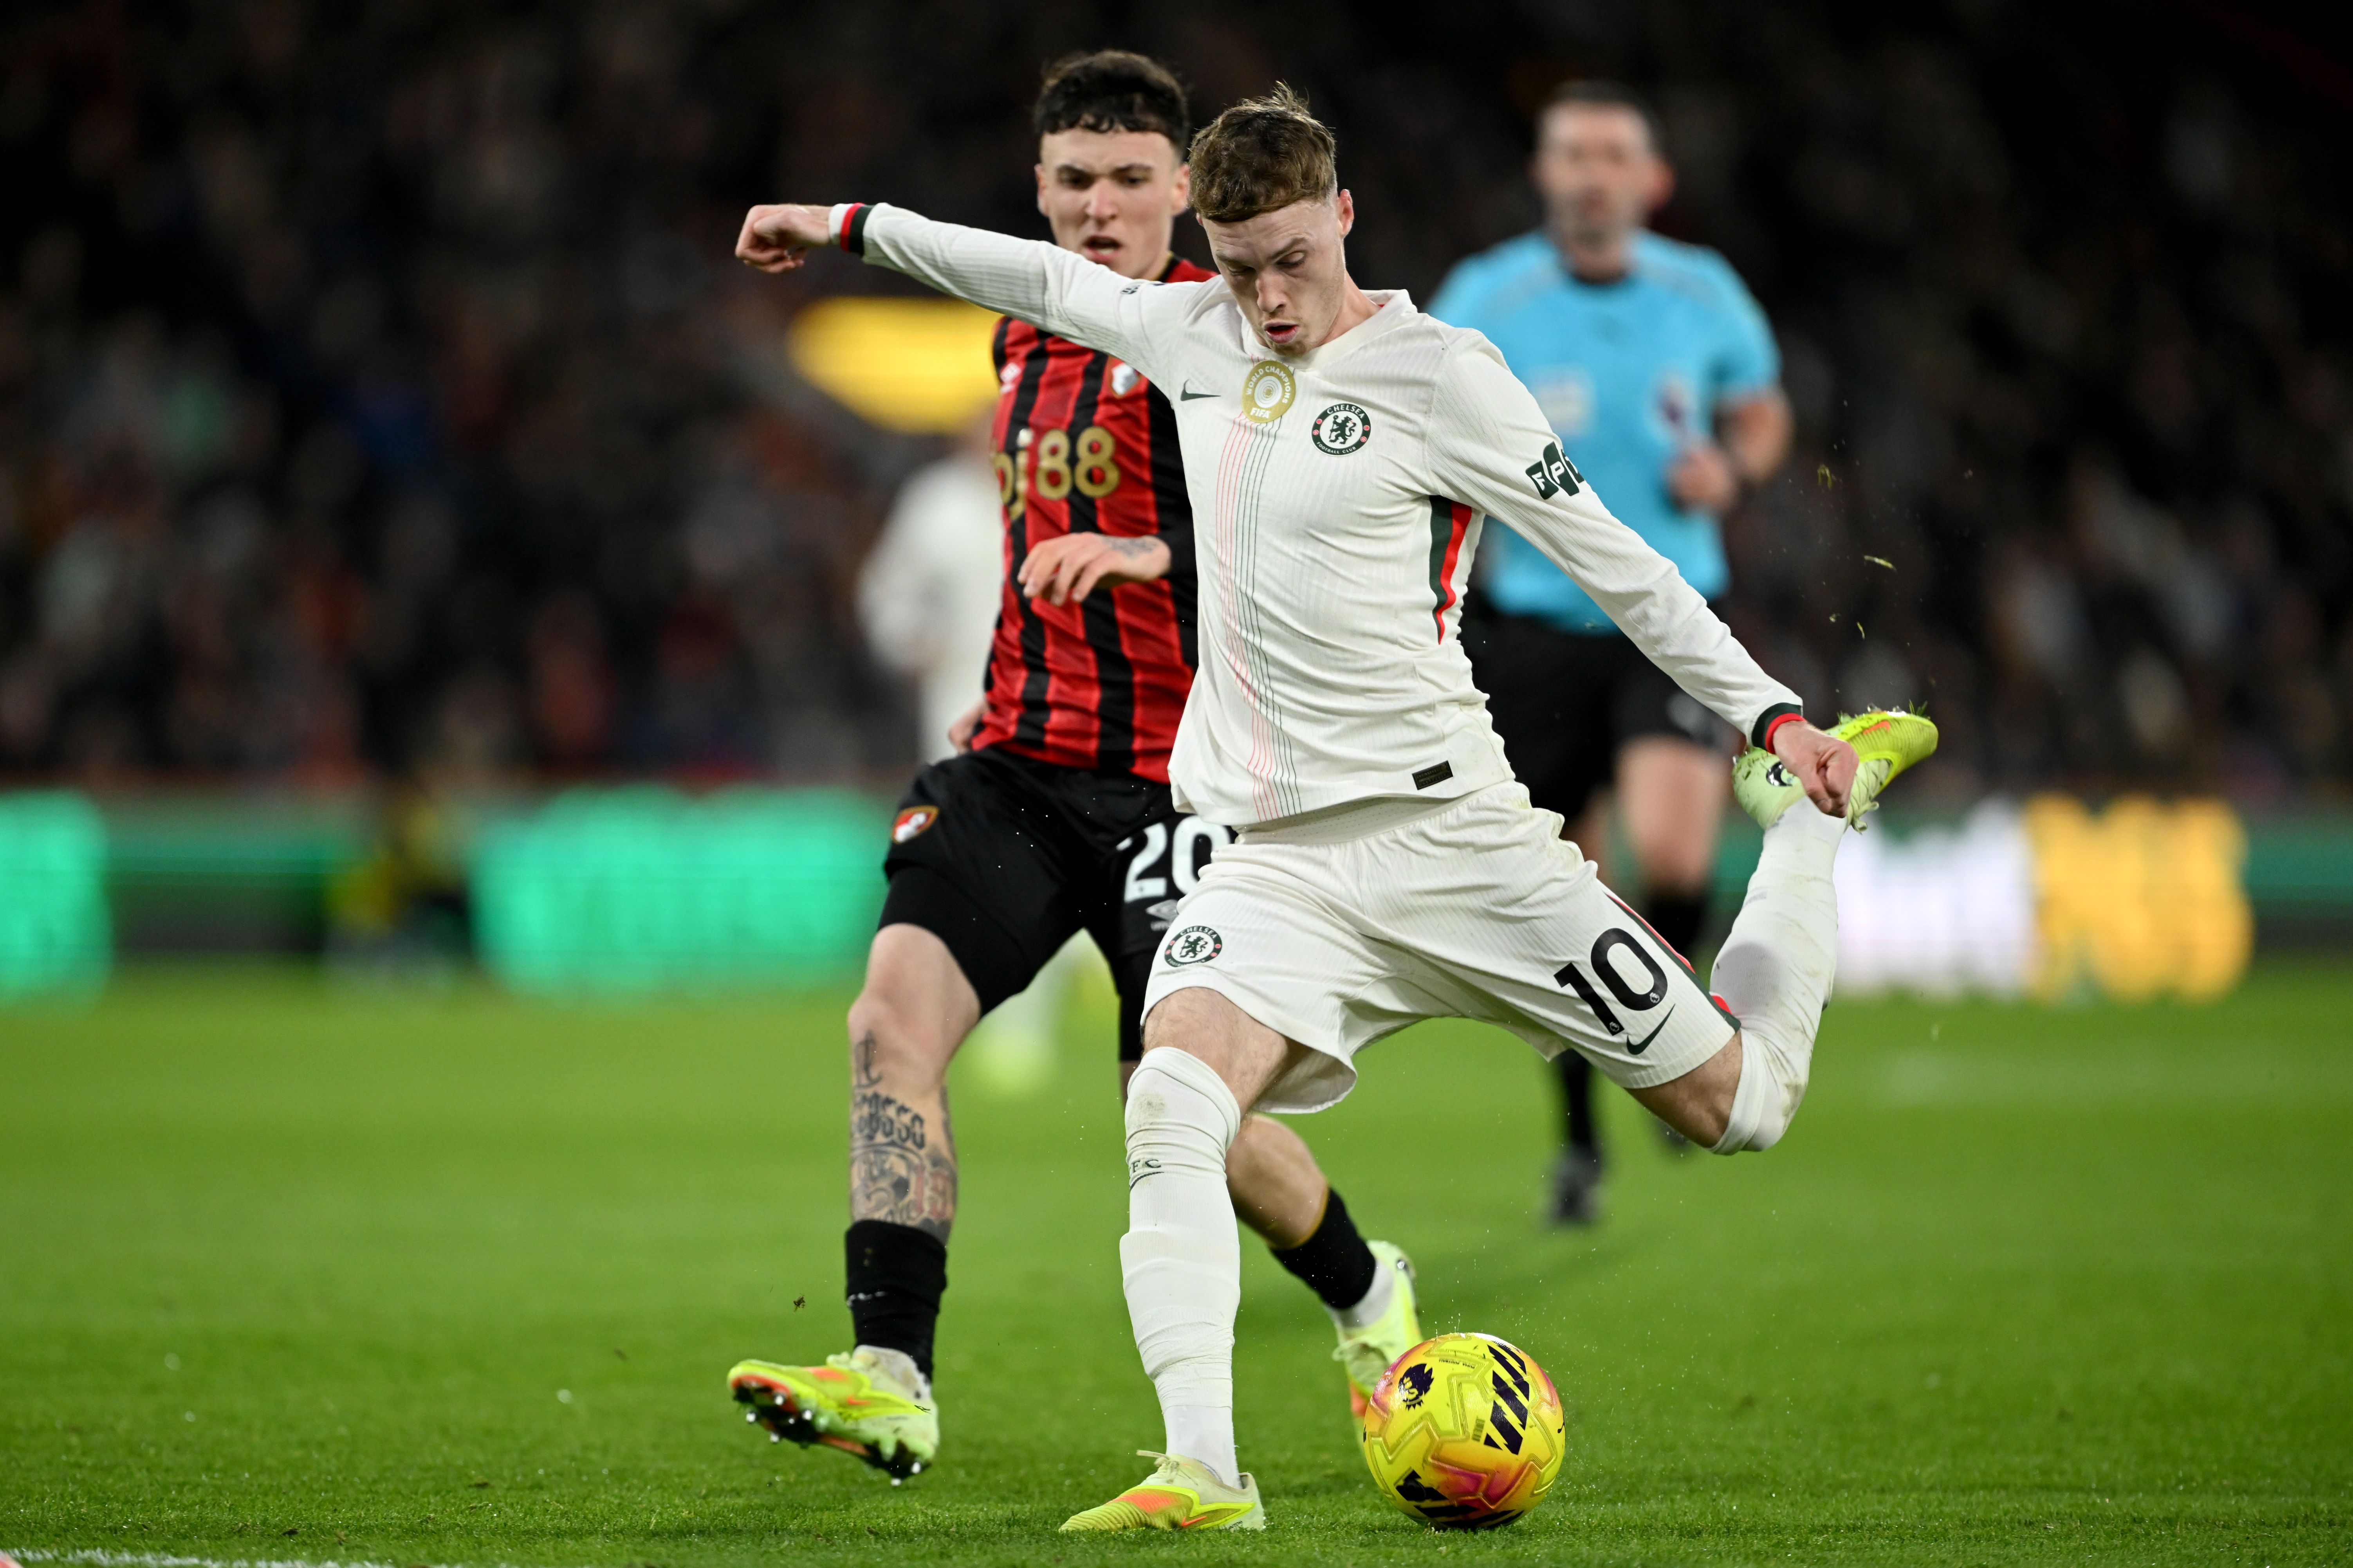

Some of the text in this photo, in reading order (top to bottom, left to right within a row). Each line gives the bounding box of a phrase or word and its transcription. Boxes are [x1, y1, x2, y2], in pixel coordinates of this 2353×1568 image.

[1246, 366, 1291, 404] WORLD CHAMPIONS
[1250, 407, 1270, 418] FIFA
[1326, 404, 1365, 419] CHELSEA
[1317, 442, 1339, 454] FOOTBALL
[1124, 815, 1231, 903] 20
[1180, 926, 1218, 939] CHELSEA
[1553, 928, 1668, 1036] 10
